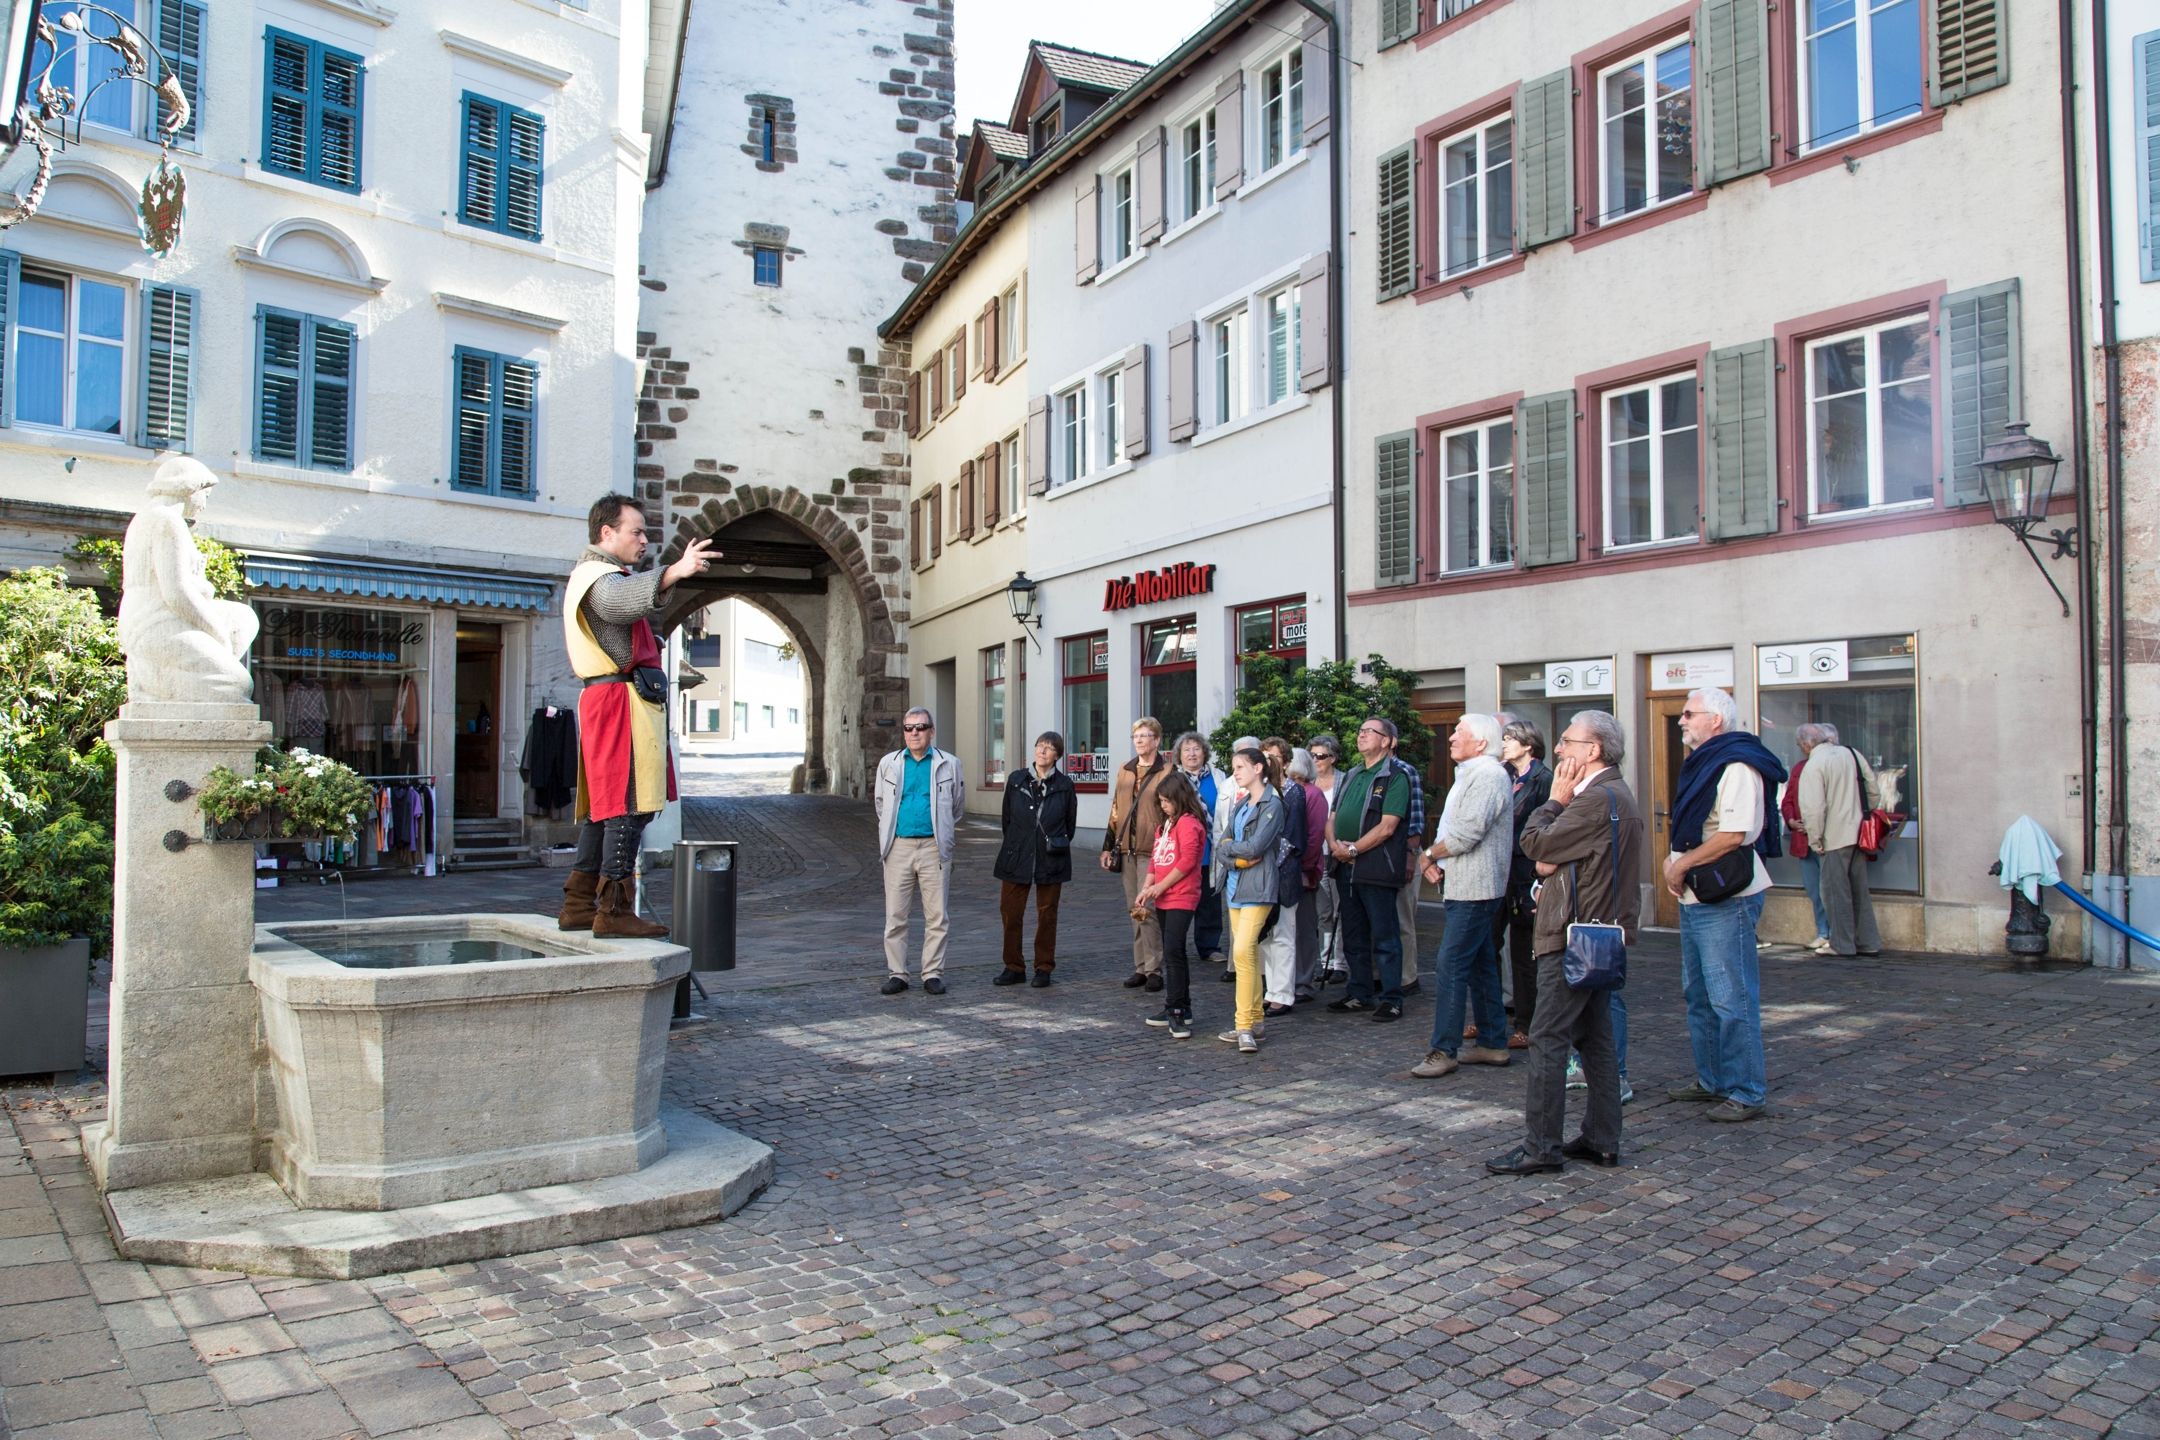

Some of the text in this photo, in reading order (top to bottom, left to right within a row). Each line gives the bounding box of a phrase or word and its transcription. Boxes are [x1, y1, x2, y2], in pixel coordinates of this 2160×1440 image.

[1103, 562, 1213, 611] Die Mobiliar
[287, 647, 397, 662] SUSI'S SECONDHAND
